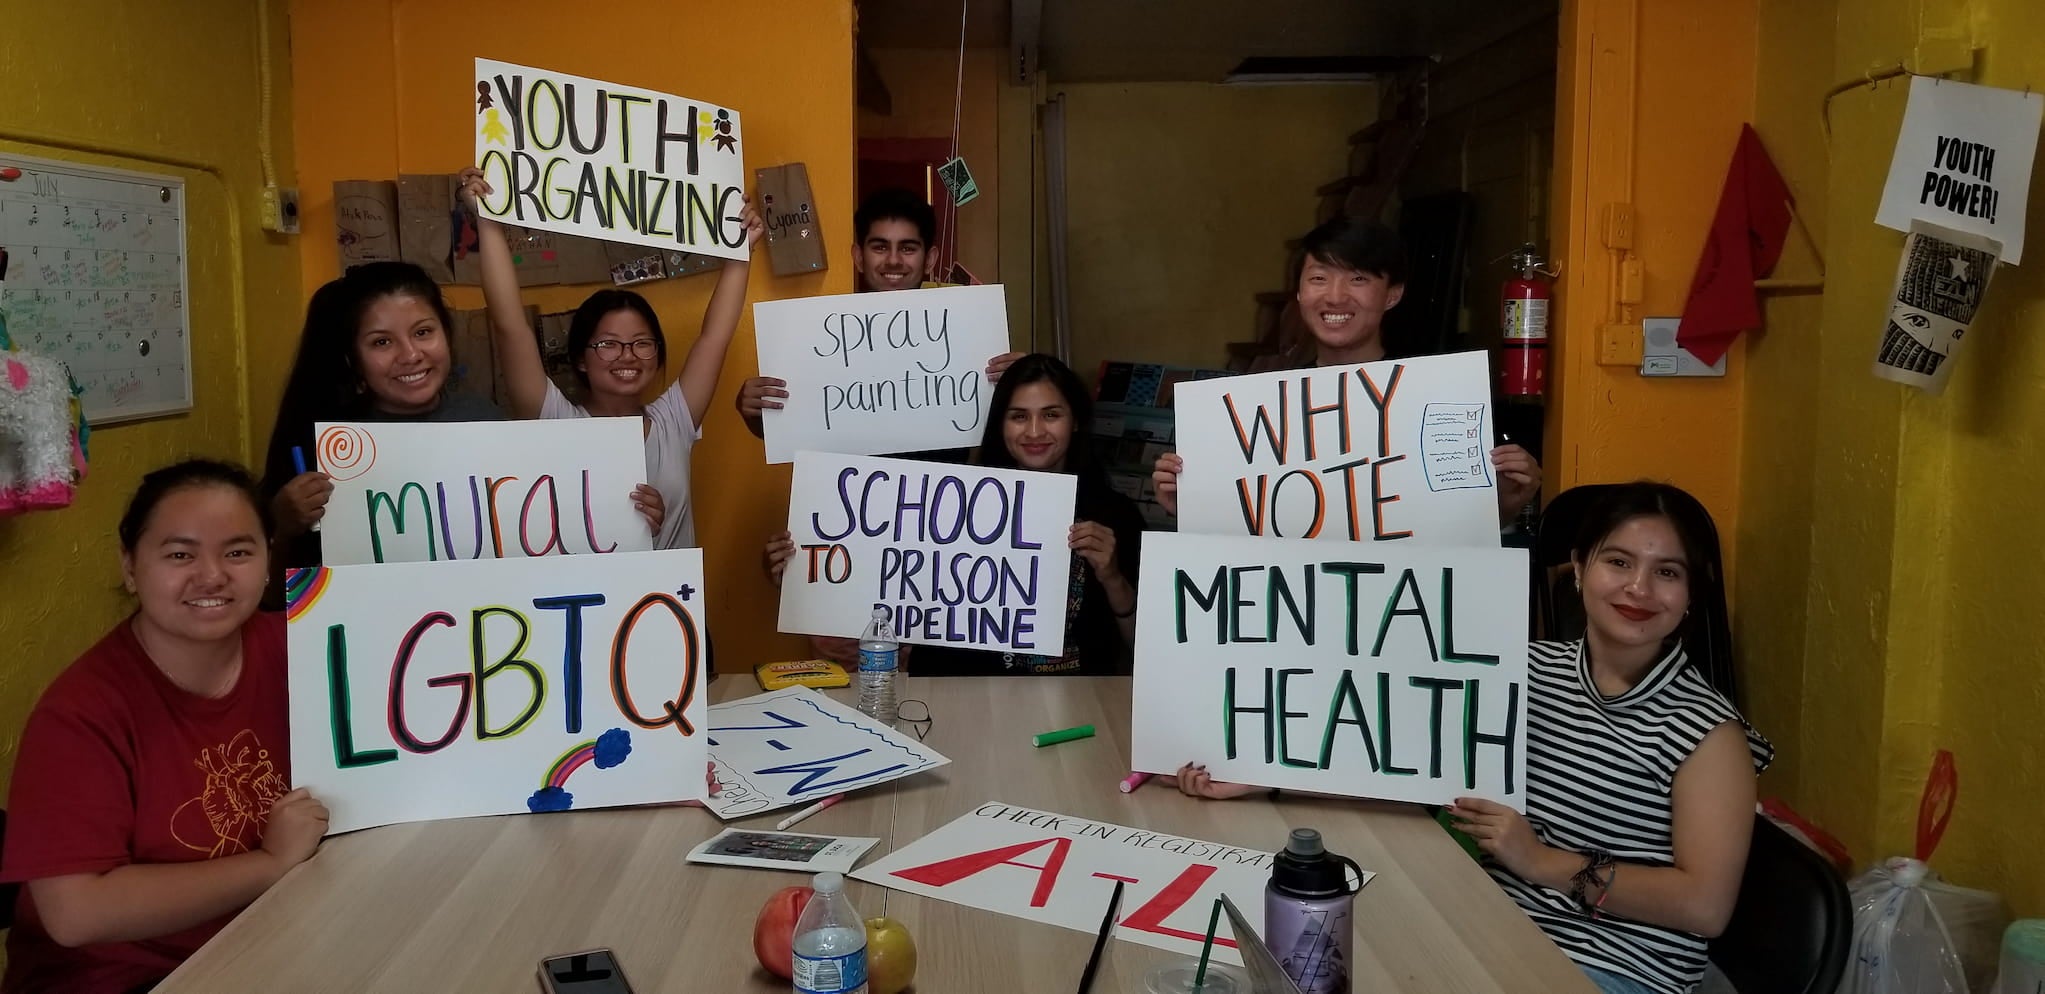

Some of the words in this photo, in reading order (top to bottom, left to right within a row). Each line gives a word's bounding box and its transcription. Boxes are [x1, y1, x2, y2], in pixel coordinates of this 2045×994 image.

[493, 74, 699, 175] YOUTH
[1933, 135, 1996, 183] YOUTH
[478, 150, 747, 248] ORGANIZING
[766, 207, 810, 237] Cyana
[1919, 171, 1999, 224] POWER!
[813, 309, 951, 373] spray
[822, 369, 980, 432] painting
[1222, 364, 1405, 465] WHY
[366, 469, 618, 563] mural
[811, 467, 1042, 550] SCHOOL
[1235, 455, 1413, 541] VOTE
[800, 544, 852, 583] TO
[879, 547, 1039, 606] PRISON
[872, 603, 1037, 649] PIPELINE
[1175, 562, 1500, 665] MENTAL
[1035, 659, 1081, 673] ORGANIZE
[1222, 667, 1519, 795] HEALTH
[975, 803, 1118, 840] CHECK-IN
